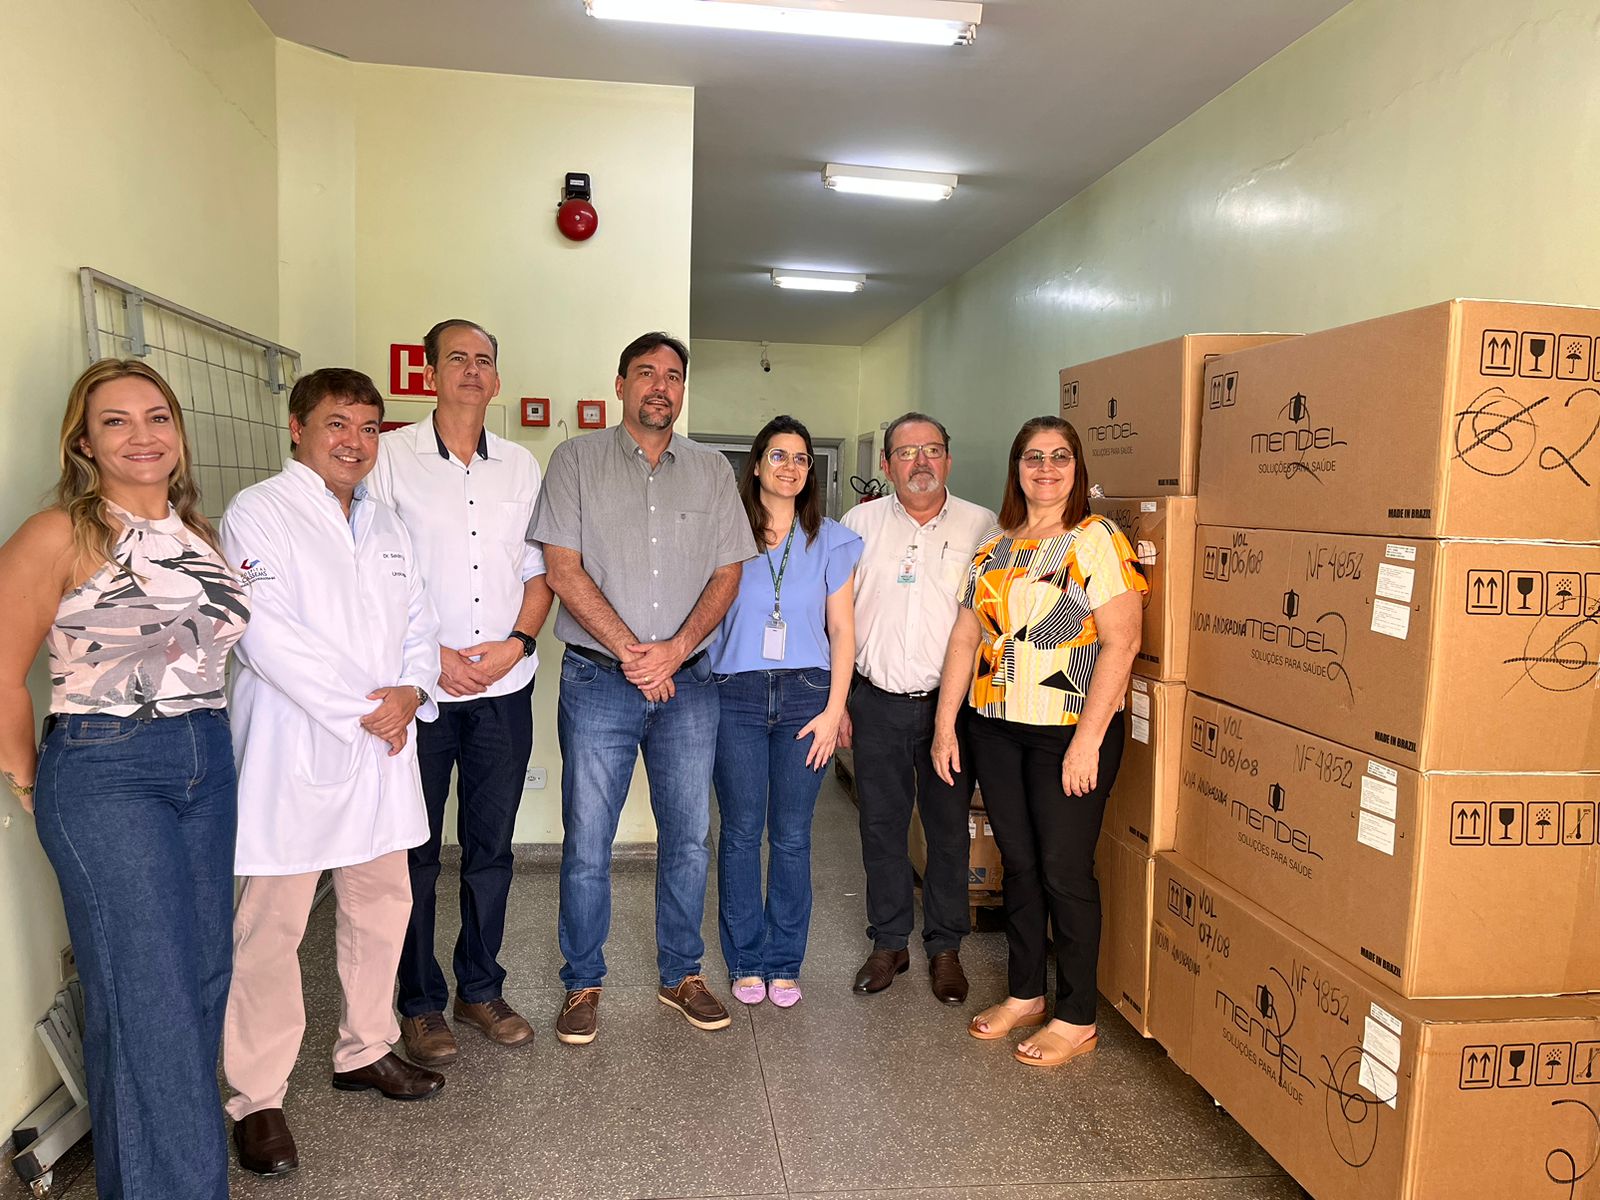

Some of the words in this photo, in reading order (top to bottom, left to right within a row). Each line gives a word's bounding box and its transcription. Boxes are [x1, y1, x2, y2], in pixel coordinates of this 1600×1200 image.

[1087, 422, 1138, 442] MENDEL
[1250, 426, 1348, 454] MENDEL
[1258, 461, 1292, 476] SOLUÇÕES
[1311, 458, 1337, 473] SAÚDE
[1388, 508, 1404, 519] MADE
[1404, 508, 1411, 519] IN
[1411, 508, 1431, 519] BRAZIL
[1232, 532, 1248, 549] VOL
[1231, 548, 1264, 578] 06/08
[1305, 543, 1328, 581] NF
[1328, 545, 1364, 582] 4852
[1245, 618, 1338, 655] MENDEL
[1250, 648, 1284, 666] SOLUÇÕES
[1284, 656, 1302, 671] PARA
[1302, 661, 1327, 678] SAÚDE
[1223, 715, 1243, 740] VOL
[1375, 730, 1390, 744] MADE
[1390, 735, 1397, 746] IN
[1397, 736, 1417, 752] BRAZIL
[1220, 746, 1259, 777] 08/08
[1292, 744, 1315, 773] NF
[1315, 749, 1353, 789] 4852
[1231, 800, 1323, 861] MENDEL
[1237, 831, 1270, 857] SOLUÇÕES
[1270, 848, 1288, 867] PARA
[1288, 858, 1313, 880] SAÚDE
[1199, 889, 1217, 918] VOL
[1199, 923, 1230, 958] 07/08
[1360, 946, 1375, 963] MADE
[1375, 954, 1382, 967] IN
[1382, 958, 1402, 978] BRAZIL
[1291, 958, 1310, 997] NF
[1313, 970, 1350, 1026] 4852
[1215, 990, 1316, 1089] MENDEL
[1222, 1027, 1257, 1065] SOLUÇÕES
[1258, 1057, 1277, 1083] PARA
[1277, 1079, 1303, 1106] SAÚDE
